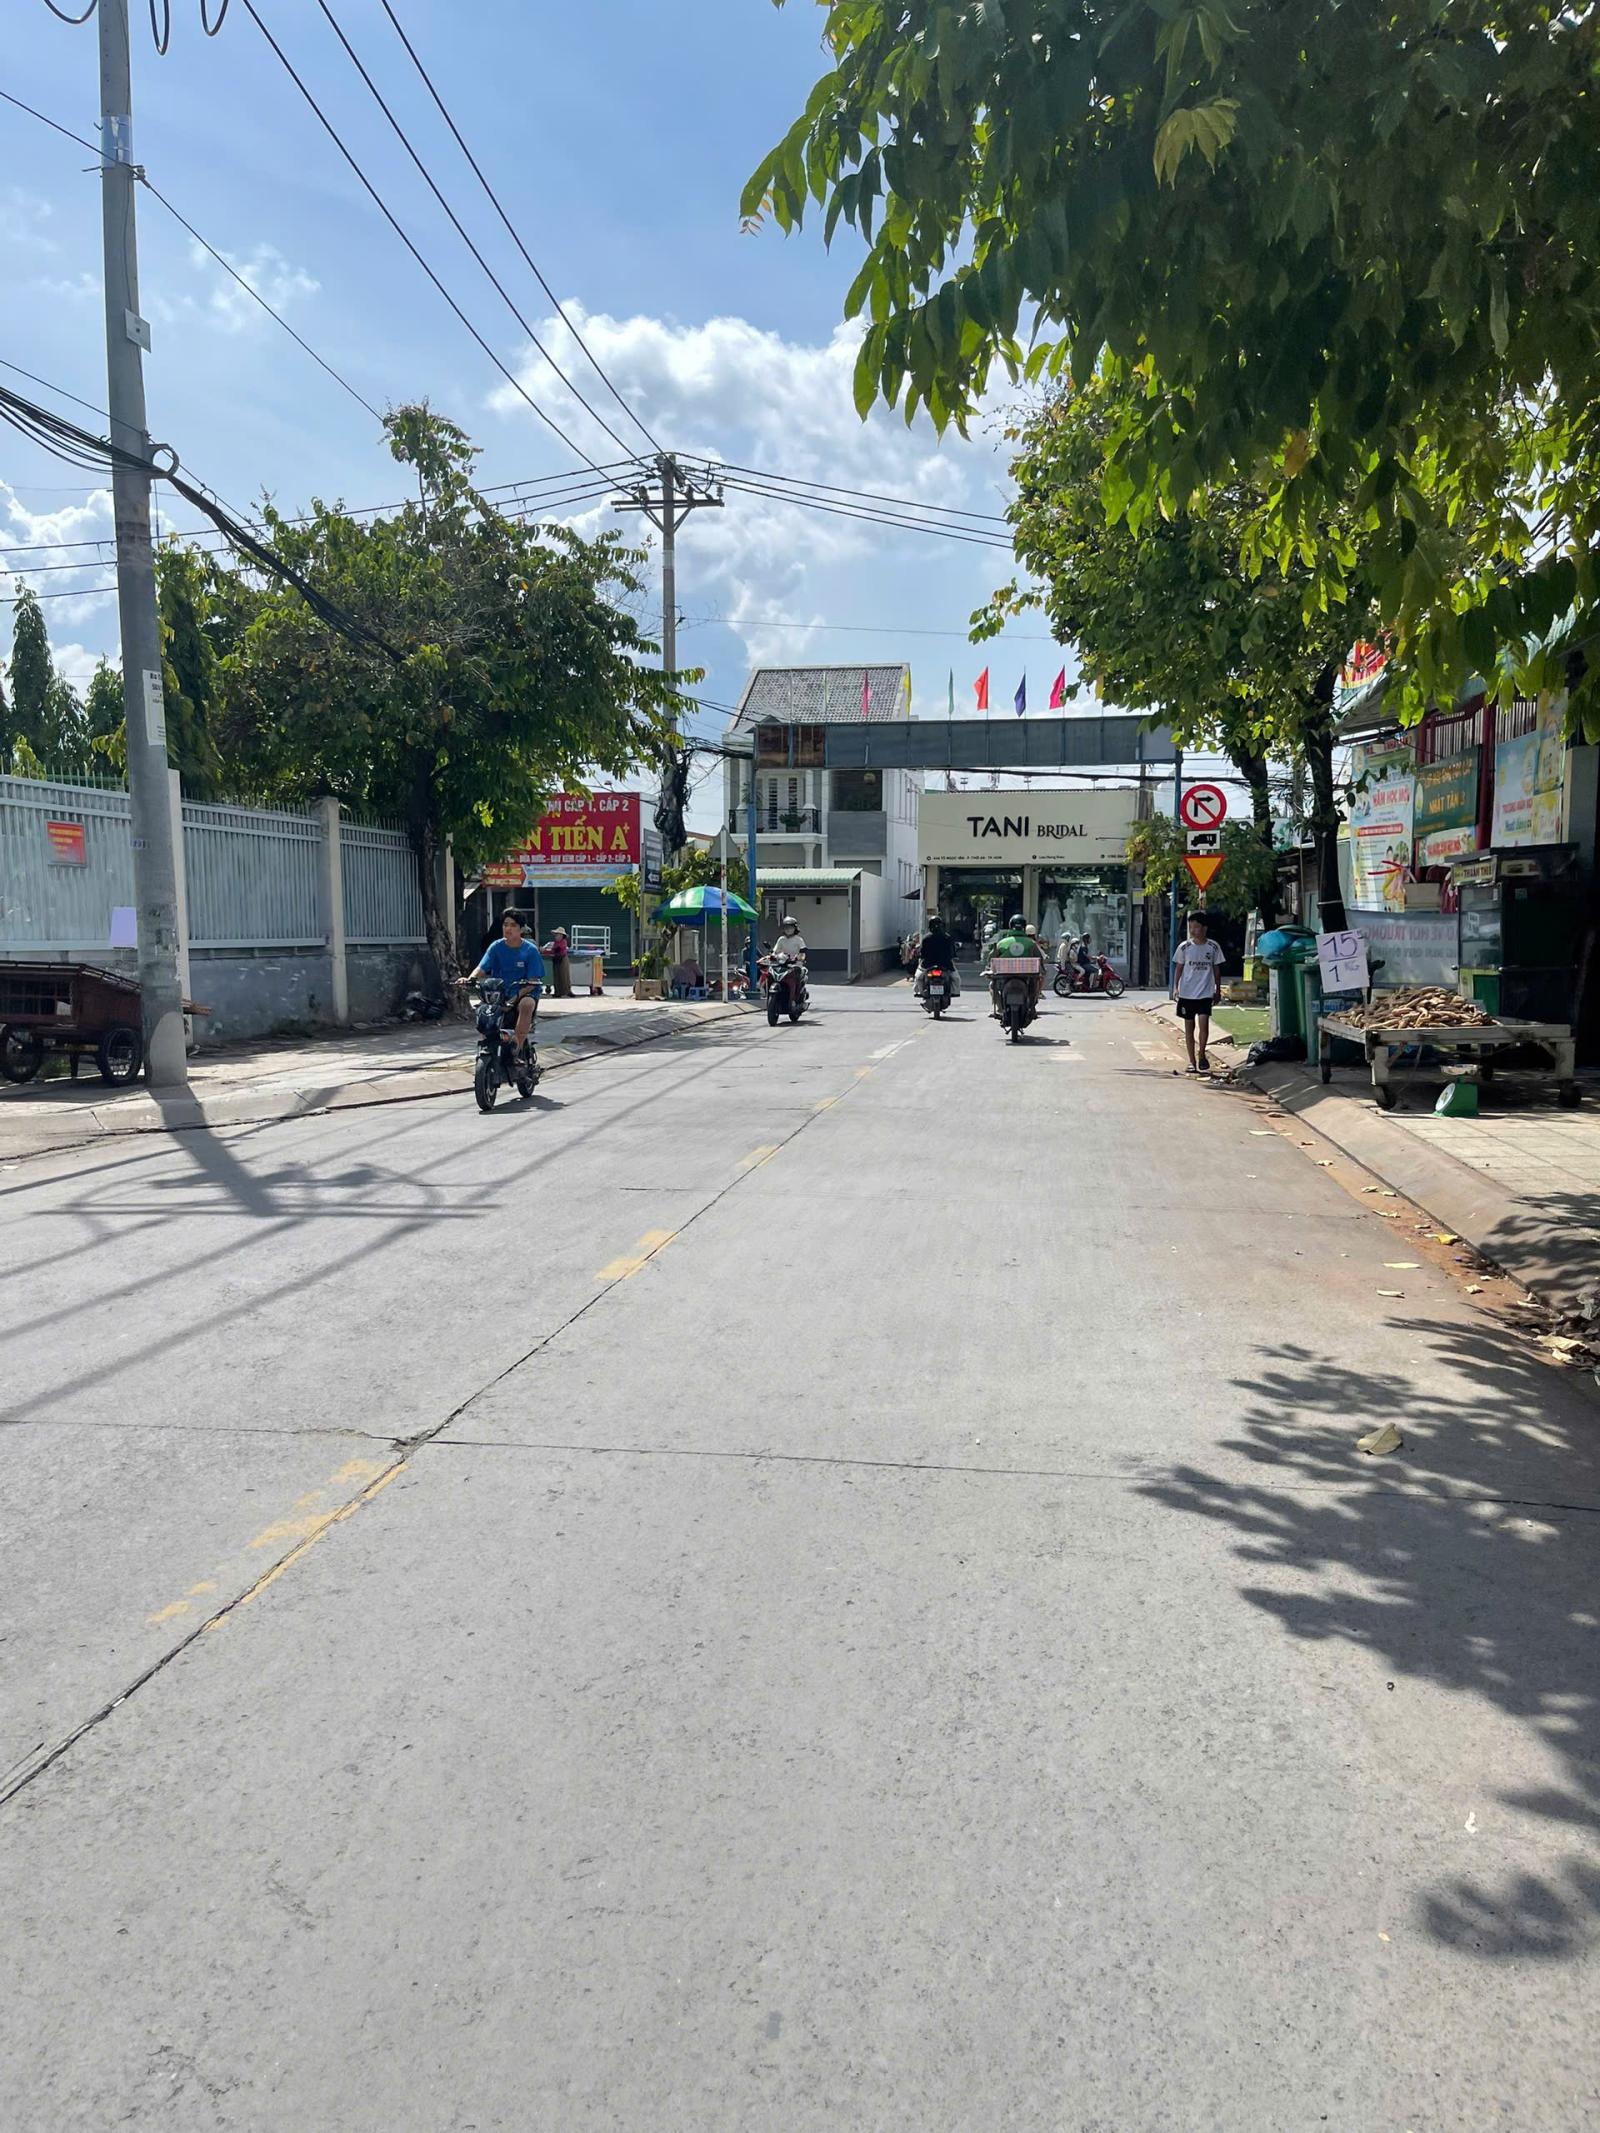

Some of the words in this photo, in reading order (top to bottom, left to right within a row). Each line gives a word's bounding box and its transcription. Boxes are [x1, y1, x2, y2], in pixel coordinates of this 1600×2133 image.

[598, 795, 618, 812] CẤP
[620, 799, 628, 811] 2
[548, 815, 604, 850] TIẾN
[966, 815, 1029, 837] TANI
[1037, 824, 1088, 840] BRIDAL
[1329, 964, 1341, 982] 1
